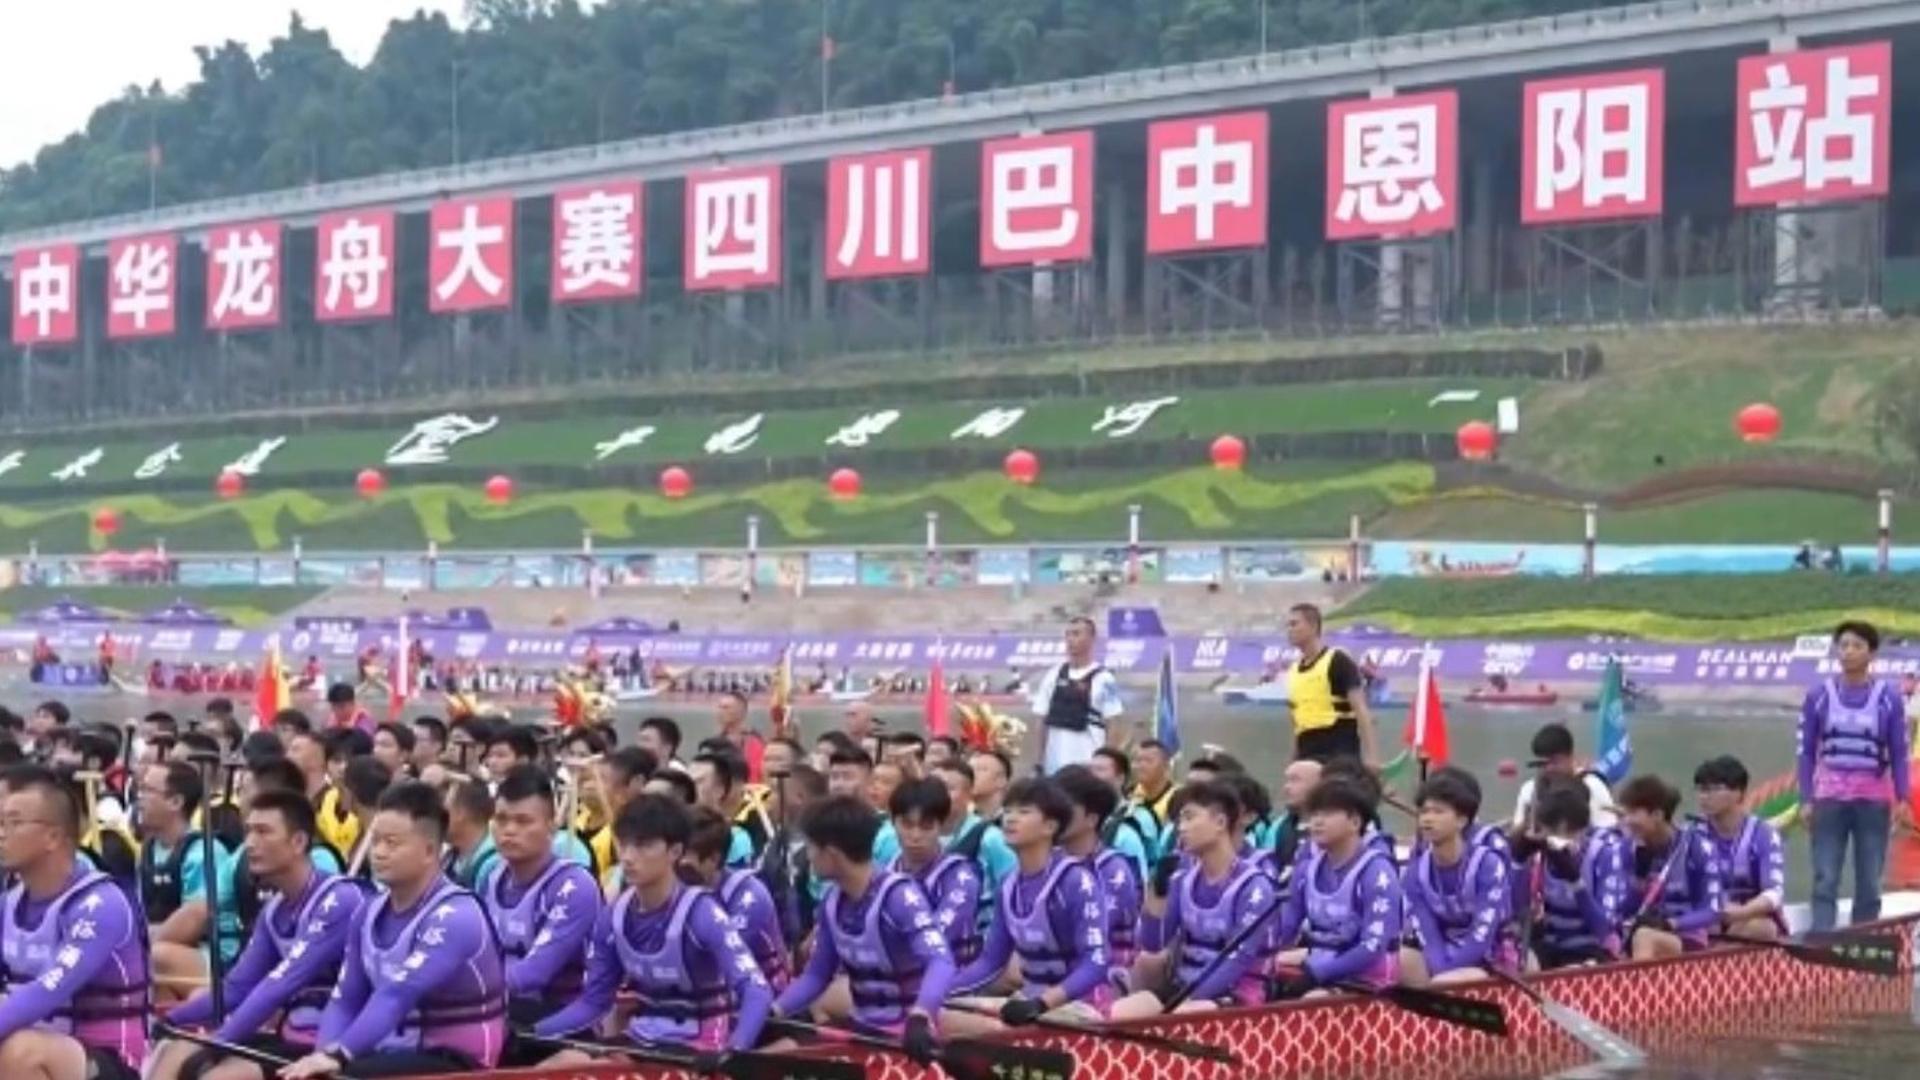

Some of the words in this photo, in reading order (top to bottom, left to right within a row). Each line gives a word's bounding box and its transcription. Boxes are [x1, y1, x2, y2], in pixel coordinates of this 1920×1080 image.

[19, 57, 1879, 338] 中华龙舟大赛四川巴中恩阳站
[1697, 650, 1792, 664] REALMAN
